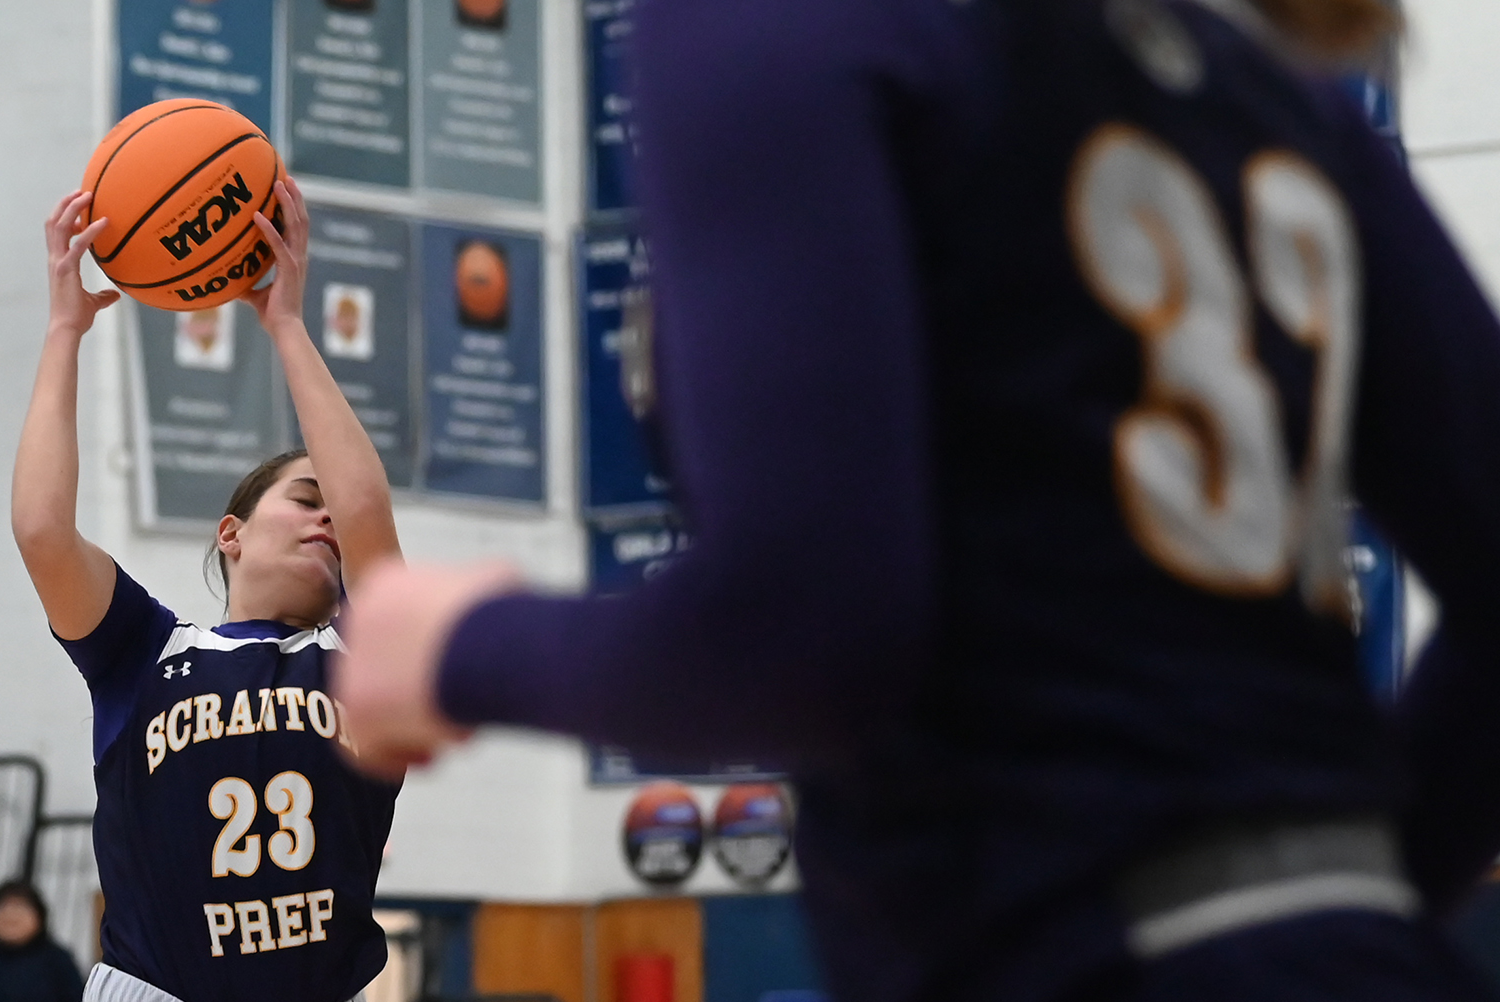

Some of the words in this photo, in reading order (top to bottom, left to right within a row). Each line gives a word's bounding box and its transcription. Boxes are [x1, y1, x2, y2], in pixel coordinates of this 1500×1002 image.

[159, 171, 253, 261] NCAA
[208, 770, 316, 878] 23
[203, 888, 335, 957] PREP
